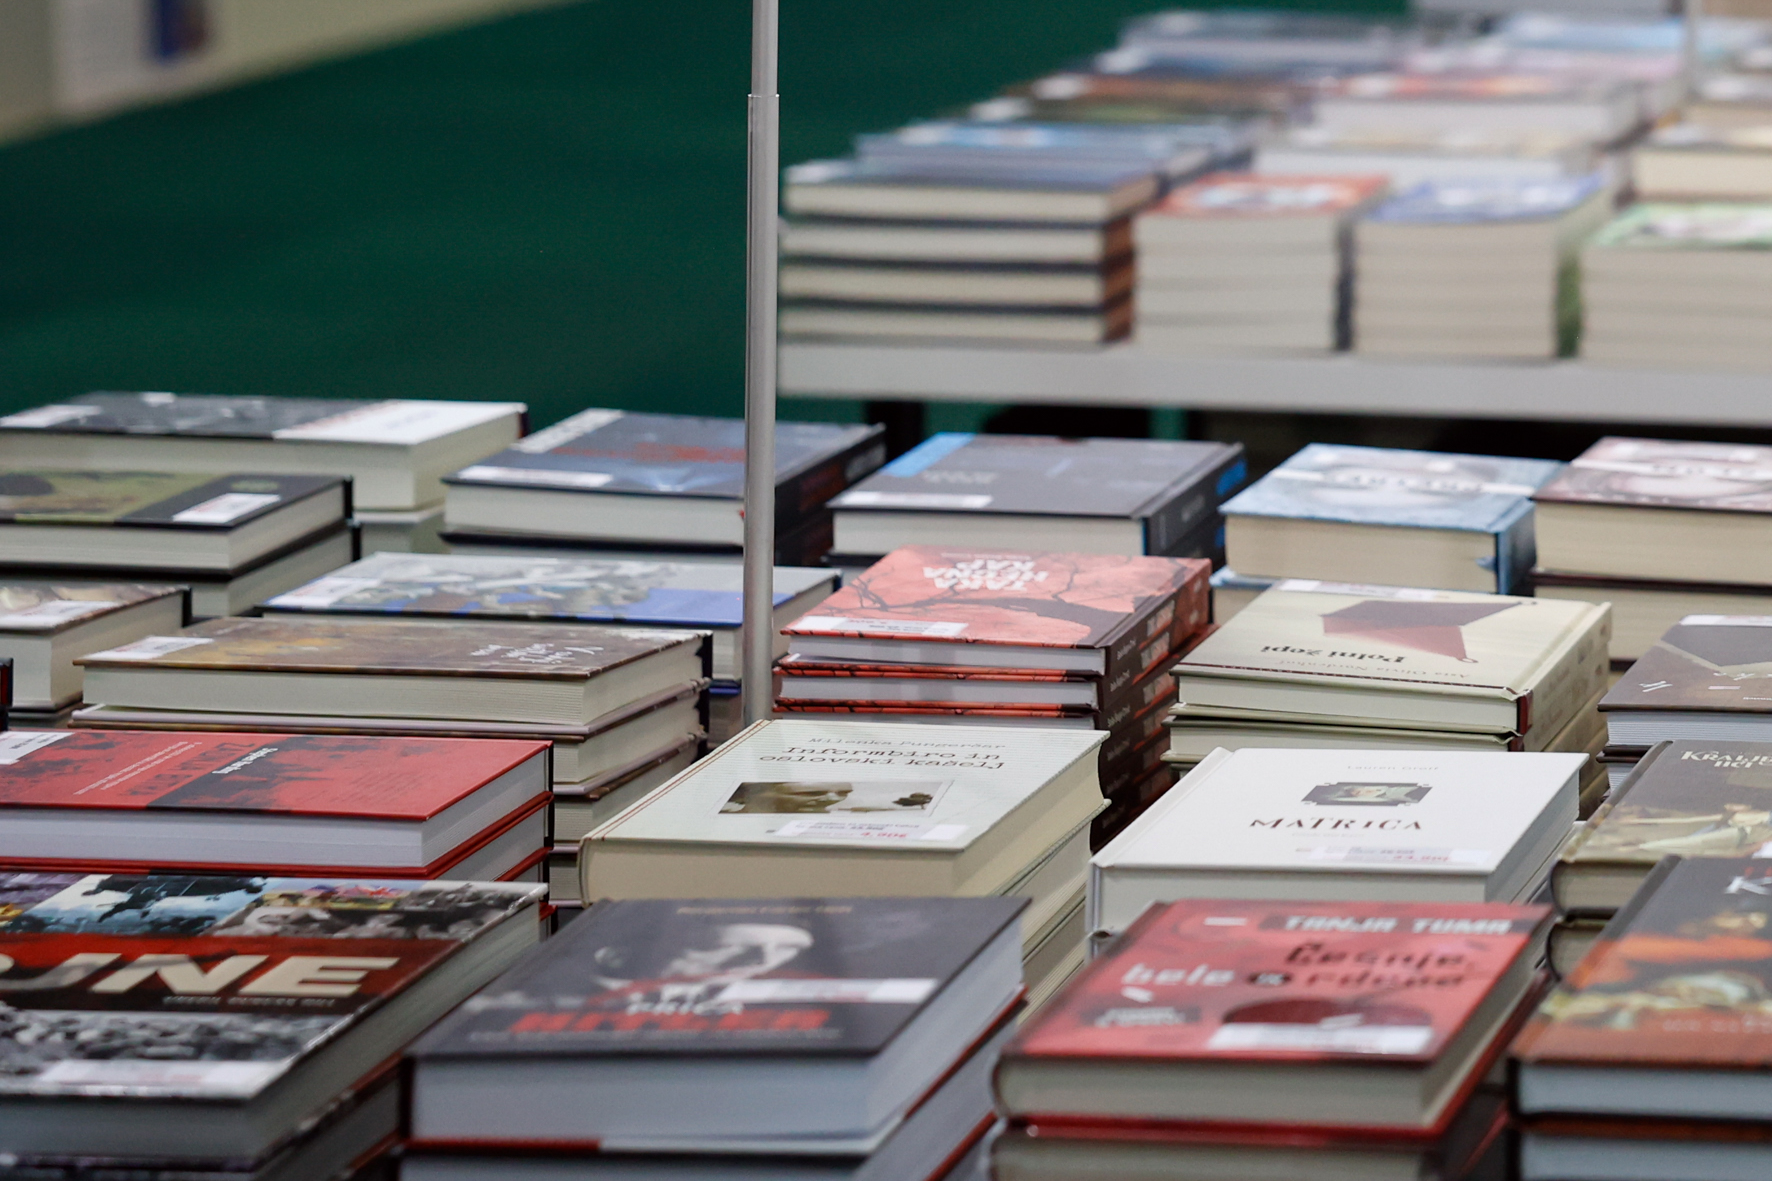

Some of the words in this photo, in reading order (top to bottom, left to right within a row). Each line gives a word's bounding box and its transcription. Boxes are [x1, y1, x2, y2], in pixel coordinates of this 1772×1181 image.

[1327, 650, 1407, 664] Polni
[808, 737, 893, 746] Milenka
[782, 746, 956, 760] Informbiro
[964, 751, 1001, 761] in
[759, 755, 895, 766] oslovski
[904, 758, 1005, 770] kašelj
[1249, 816, 1422, 830] MATRICA
[1284, 915, 1399, 933] TANJA
[1412, 918, 1512, 935] TUMA
[0, 952, 400, 996] JNE
[1121, 962, 1236, 986] bele
